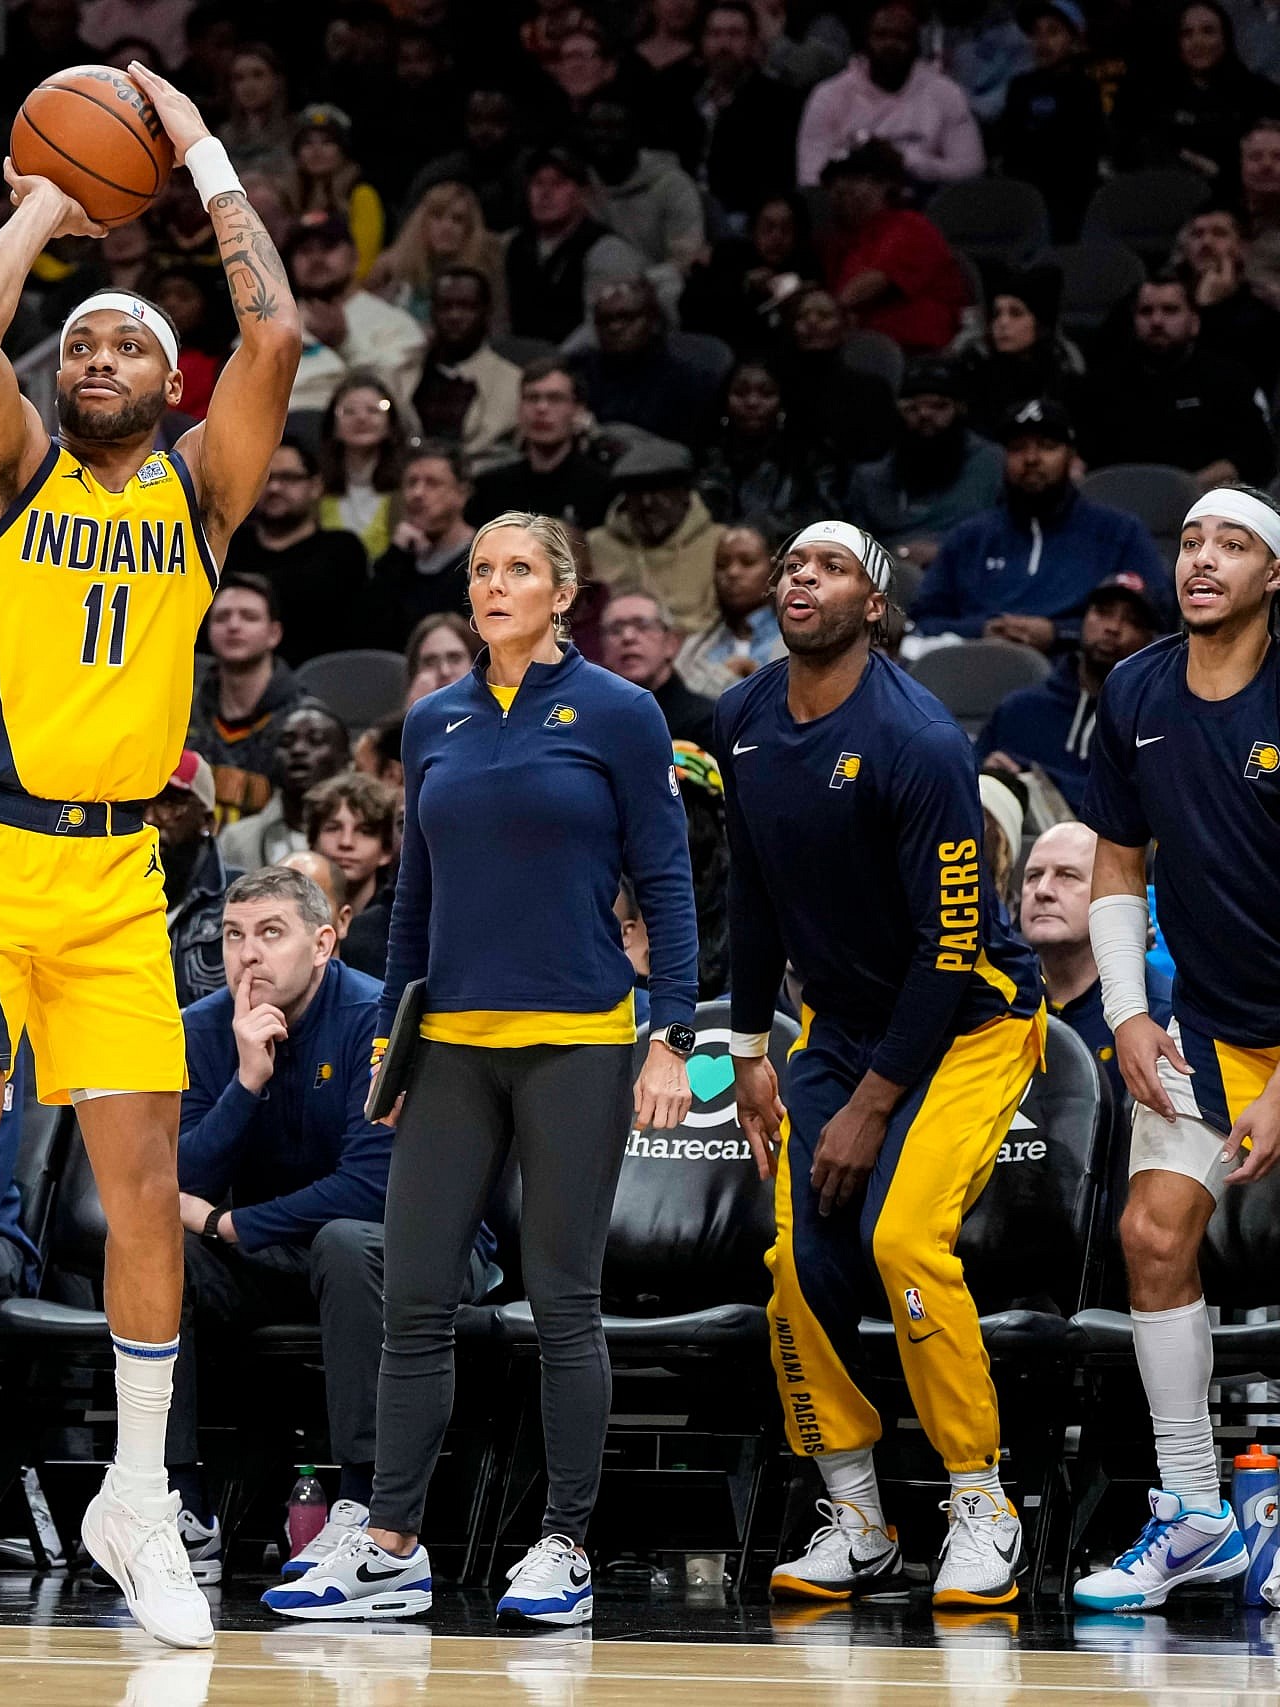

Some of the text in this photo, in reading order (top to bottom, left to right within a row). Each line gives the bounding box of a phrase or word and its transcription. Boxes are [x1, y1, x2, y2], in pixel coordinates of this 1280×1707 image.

[20, 508, 187, 575] INDIANA
[80, 582, 131, 667] 11
[935, 838, 979, 972] PACERS
[624, 1130, 774, 1160] harecar
[775, 1316, 825, 1454] INDIANA PACERS
